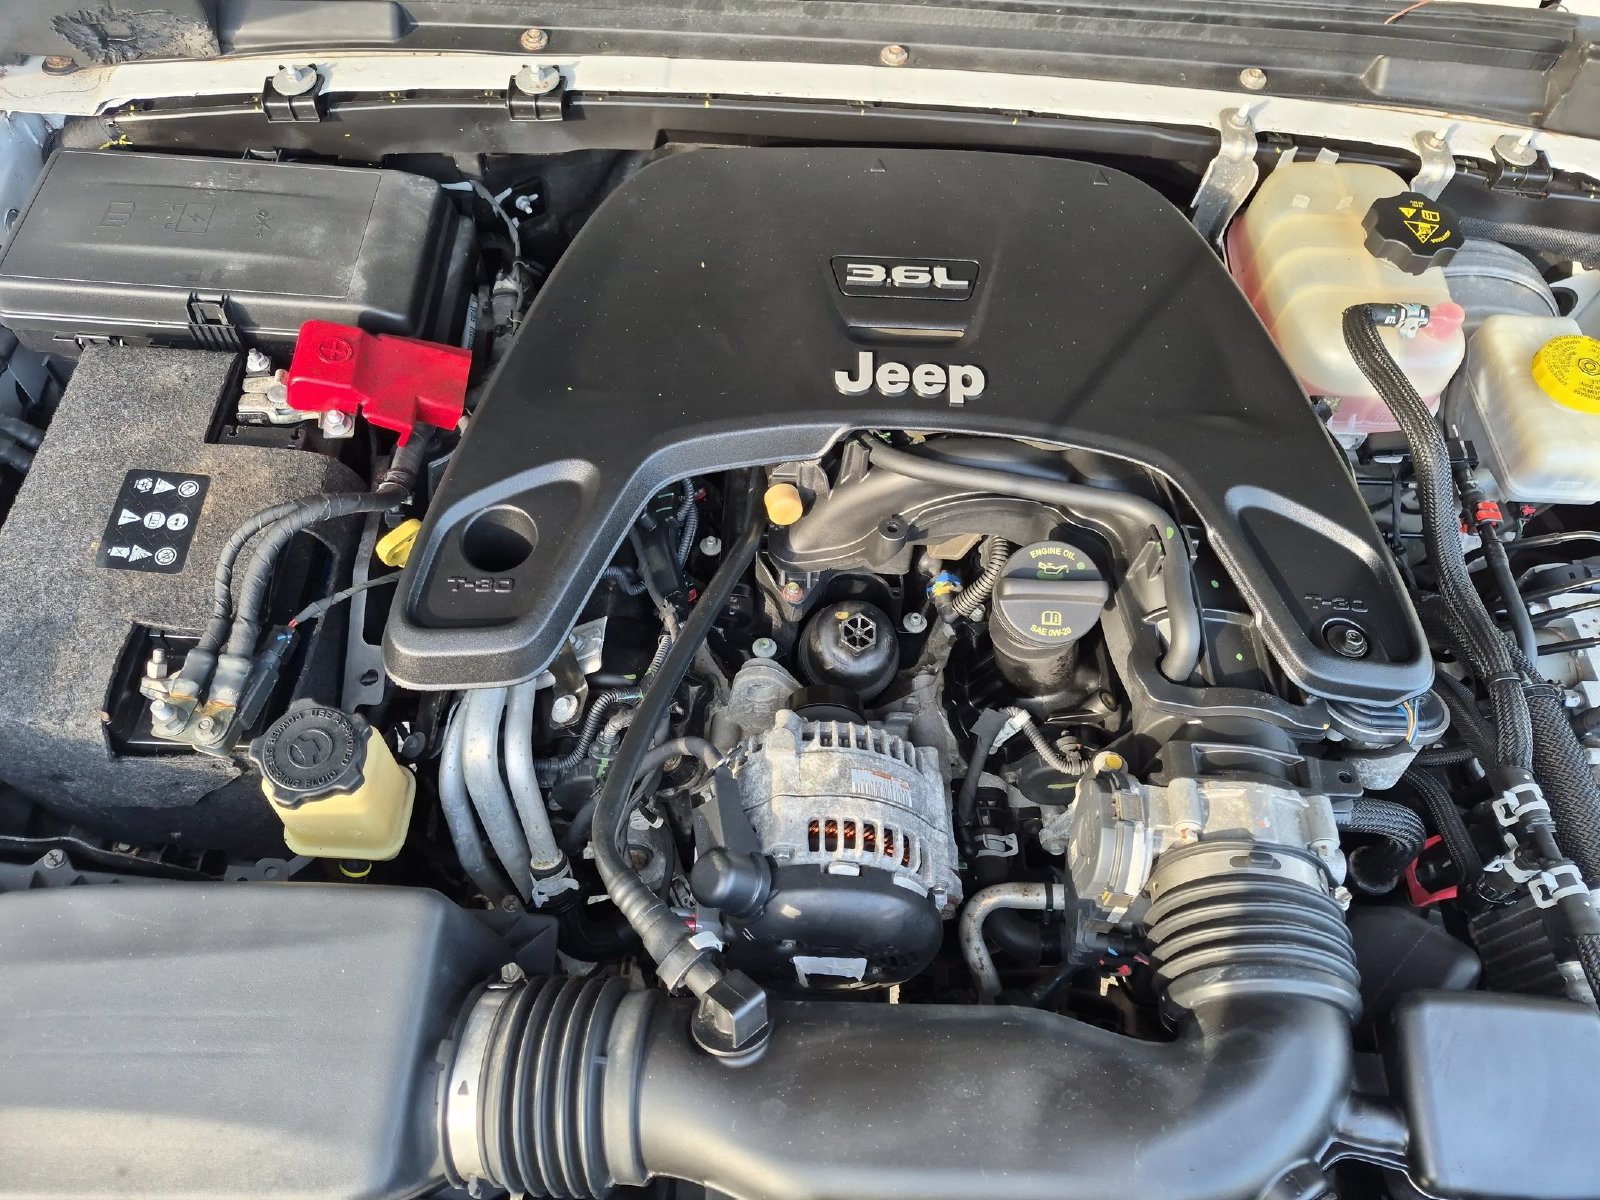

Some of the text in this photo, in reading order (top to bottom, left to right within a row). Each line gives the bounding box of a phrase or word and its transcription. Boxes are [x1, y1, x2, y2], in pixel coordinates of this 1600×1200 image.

[846, 264, 968, 289] 3.6L
[834, 351, 985, 407] Jeep
[1030, 547, 1075, 560] ENGINE OIL
[1030, 624, 1072, 637] SAE 0W-20
[266, 712, 338, 788] POWER STEERING FLUID
[310, 709, 356, 767] USE APPROVED
